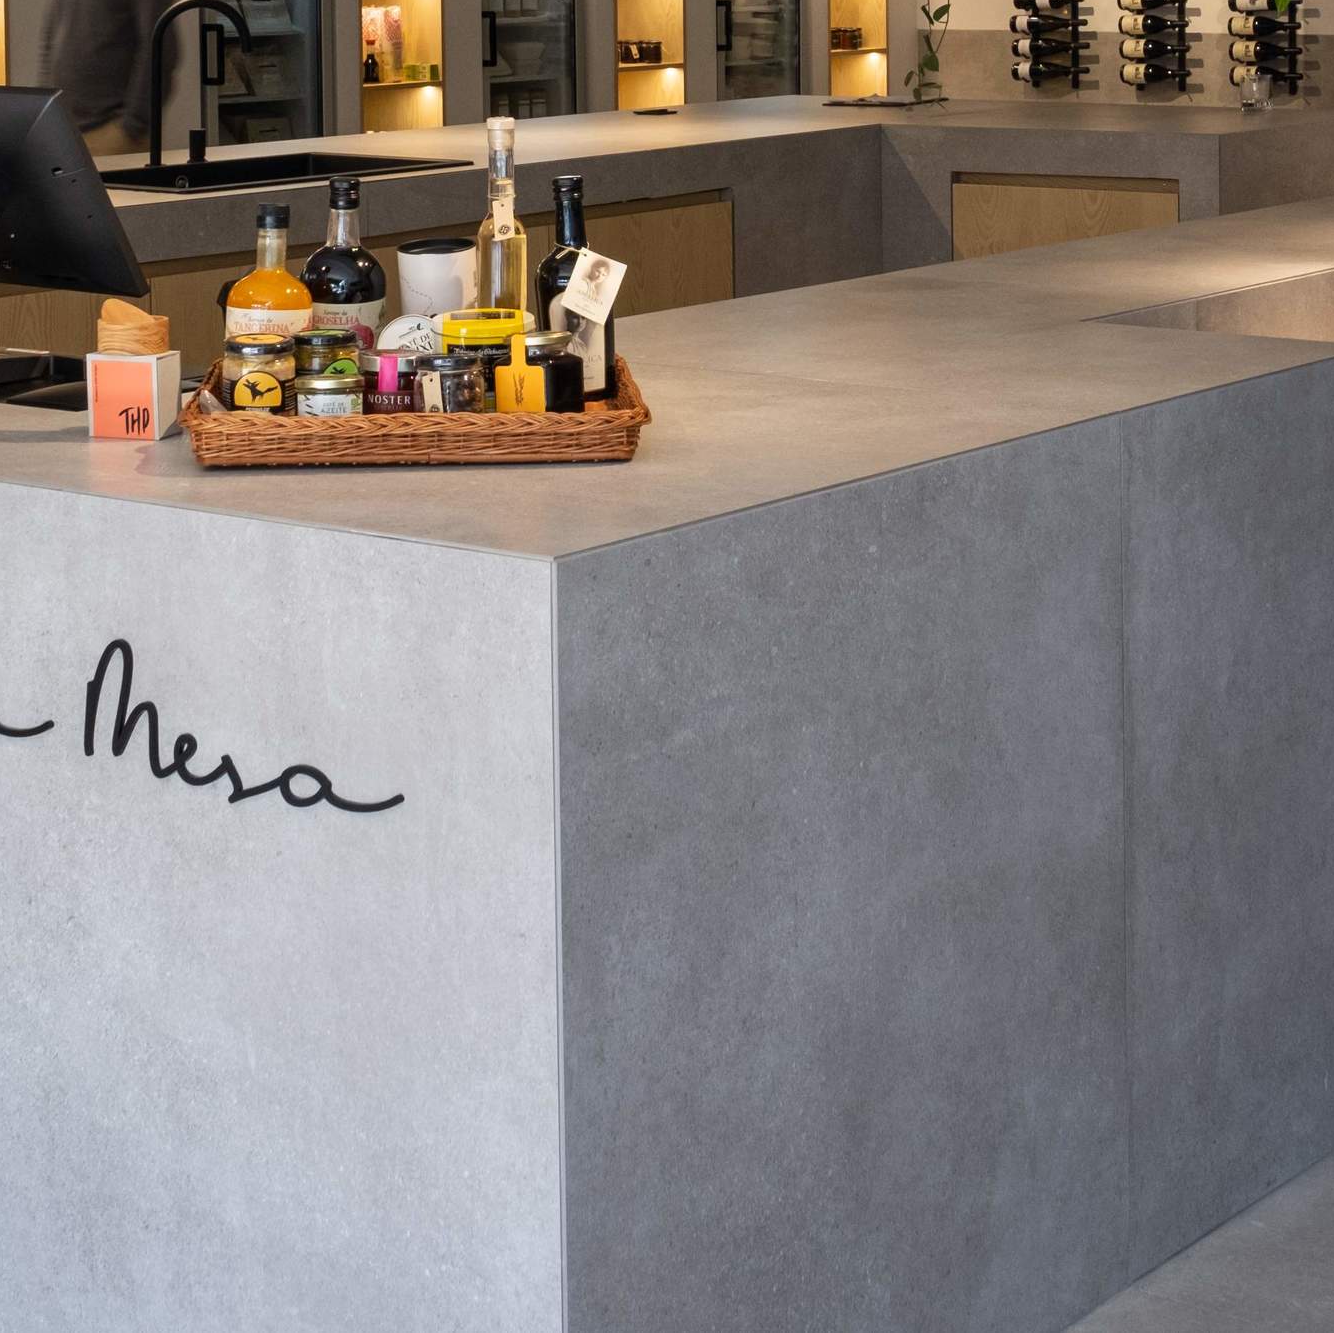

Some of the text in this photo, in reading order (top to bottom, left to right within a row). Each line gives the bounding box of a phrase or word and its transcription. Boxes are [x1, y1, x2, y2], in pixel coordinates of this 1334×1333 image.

[234, 322, 291, 333] TANGERINA
[367, 394, 411, 405] NOSTER
[83, 638, 405, 814] Mesa
